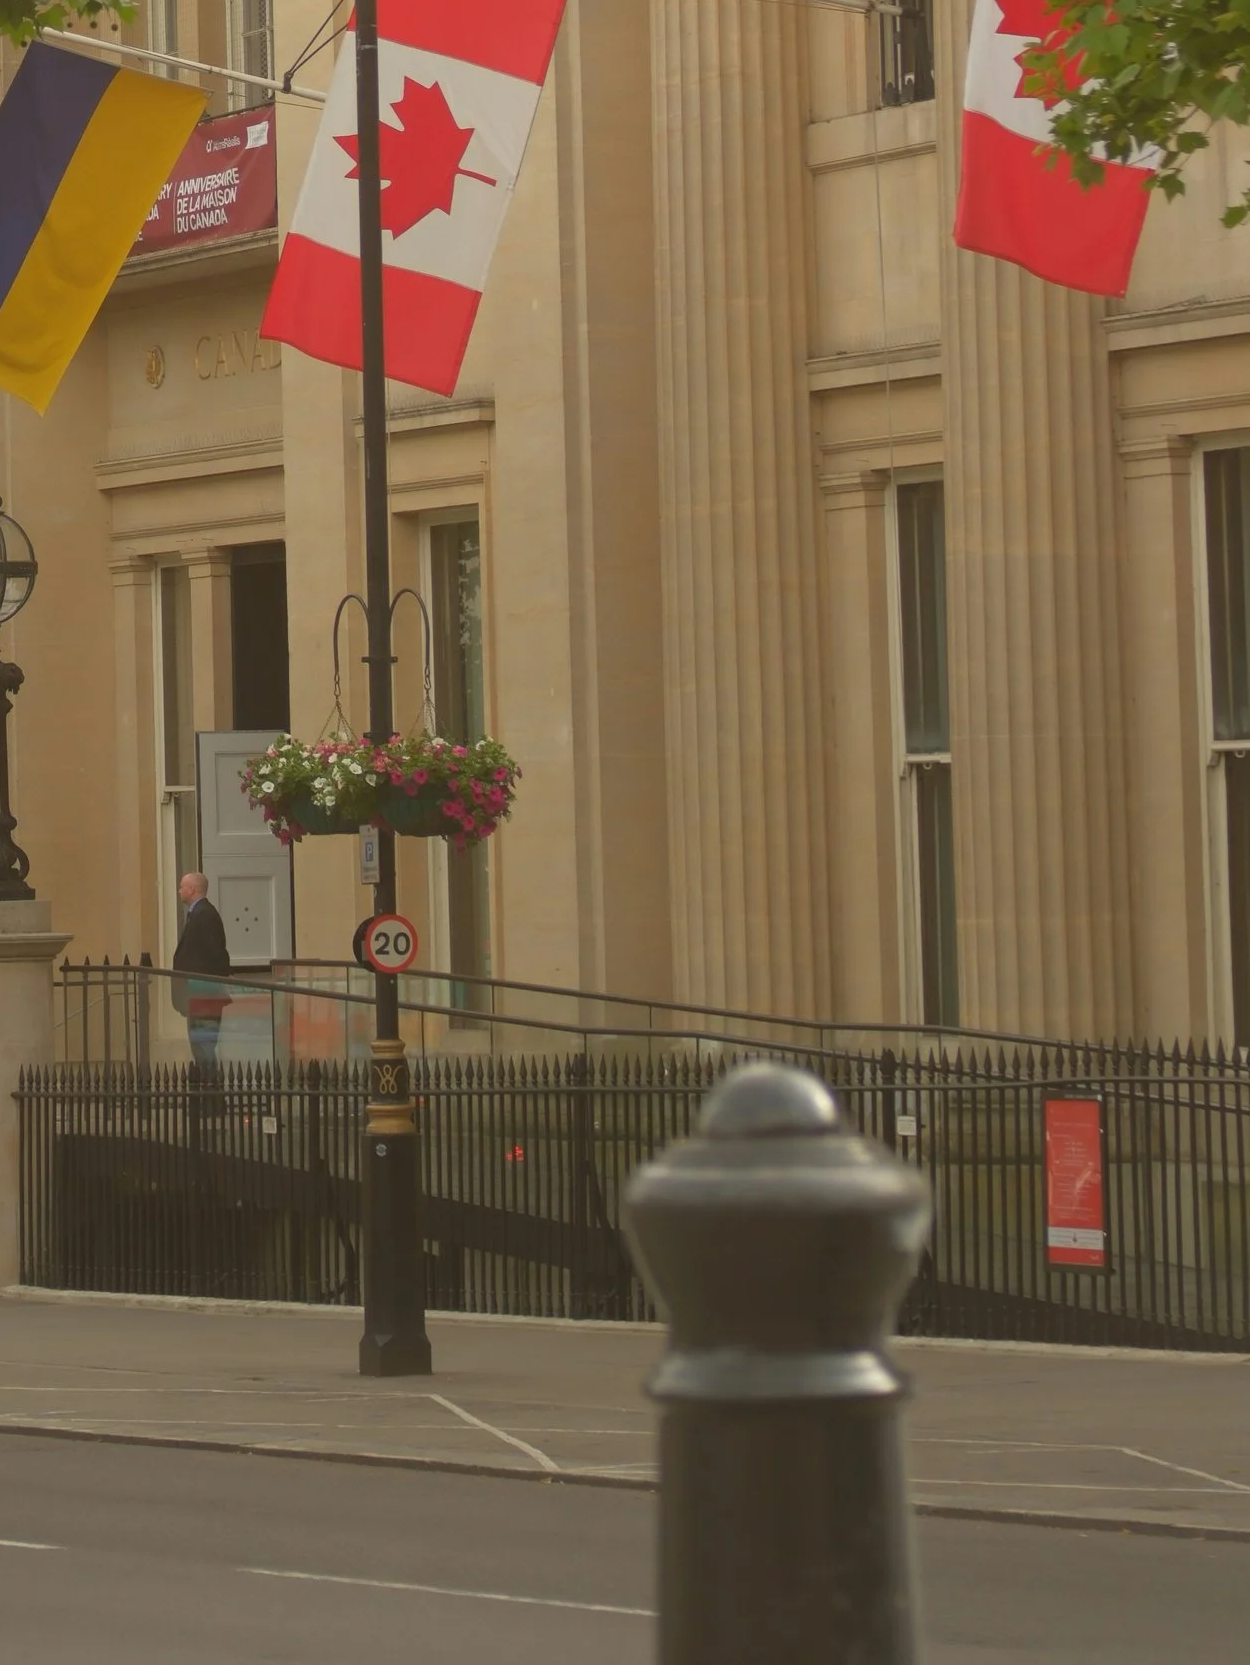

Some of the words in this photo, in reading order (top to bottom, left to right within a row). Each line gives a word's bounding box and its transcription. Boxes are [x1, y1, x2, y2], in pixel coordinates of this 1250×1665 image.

[177, 167, 240, 197] ANNIVERSAIRE
[177, 197, 188, 215] DE
[190, 195, 200, 213] LA
[201, 186, 238, 209] MAISON
[177, 215, 188, 234] DU
[190, 208, 228, 231] CANADA
[374, 931, 411, 956] 20
